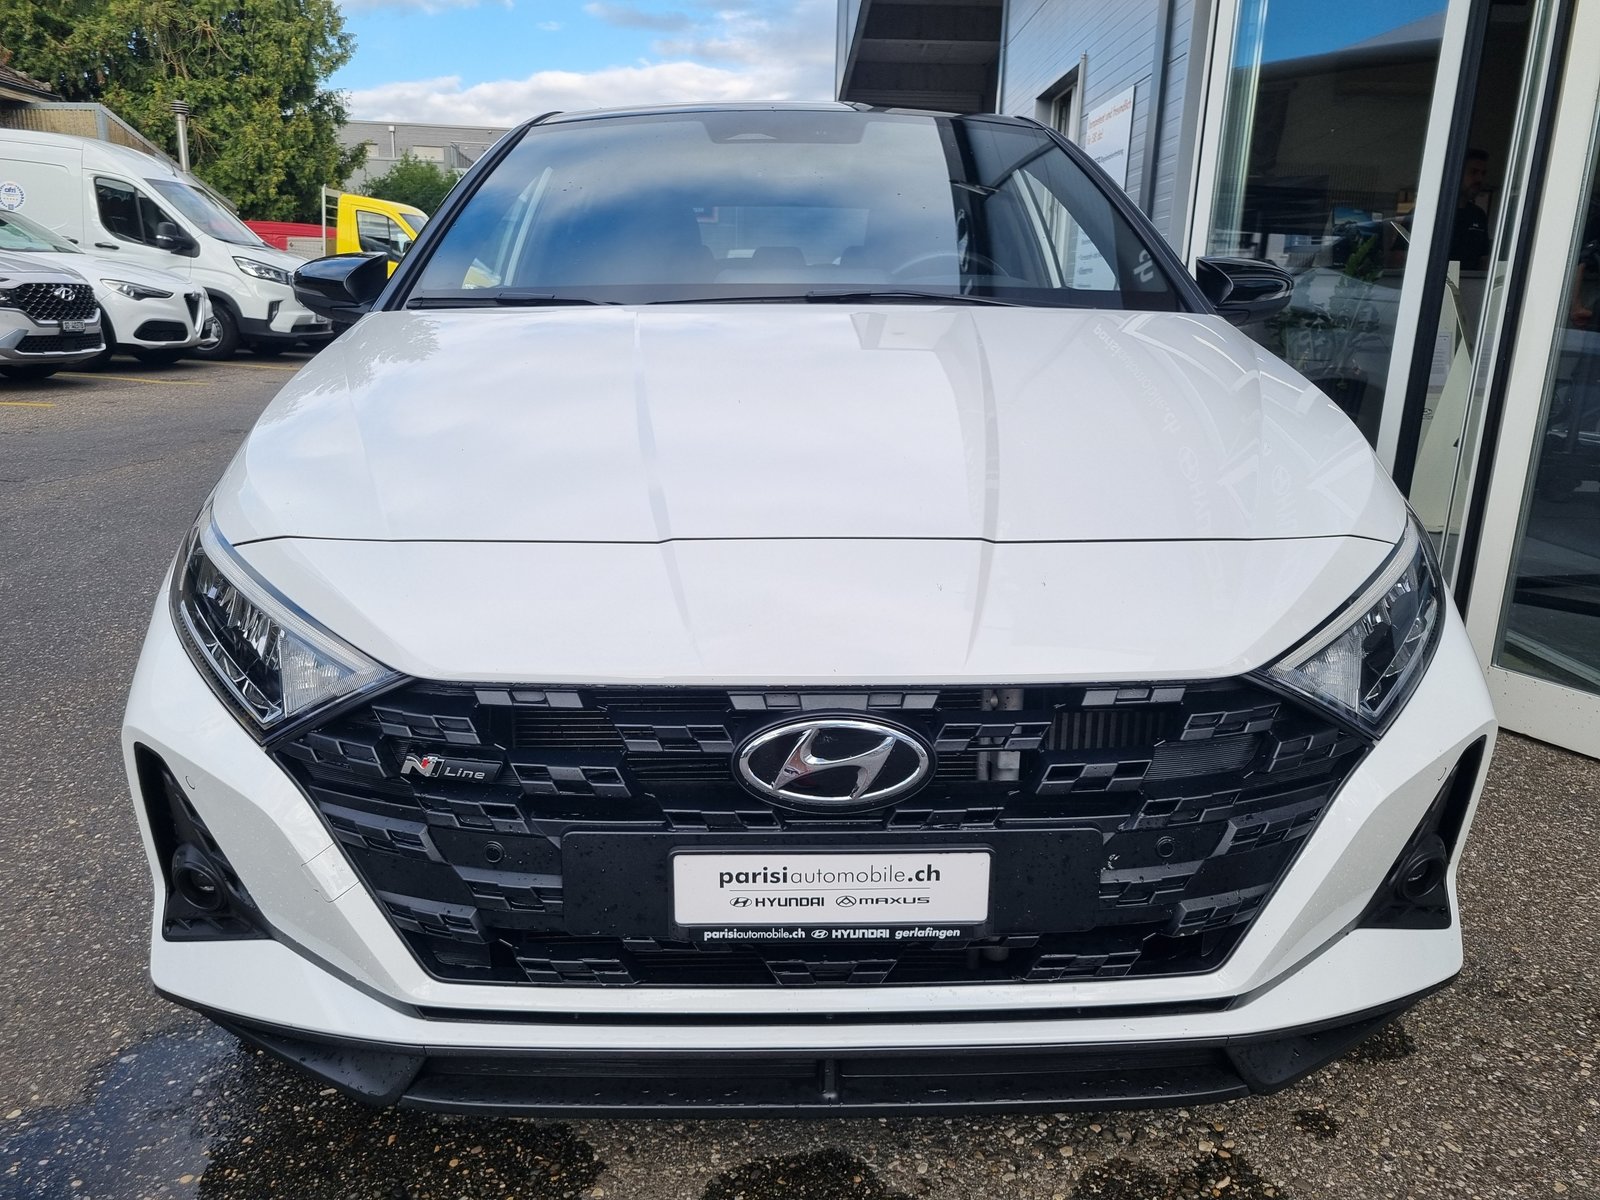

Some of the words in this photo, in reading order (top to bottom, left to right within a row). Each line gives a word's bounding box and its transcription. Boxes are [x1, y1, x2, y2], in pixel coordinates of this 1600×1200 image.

[444, 767, 485, 779] Line
[719, 864, 941, 888] parisiautomobile.ch
[755, 897, 824, 907] HYUNDAI
[859, 896, 930, 904] MAXUS
[704, 928, 805, 941] parisiautomobile.ch
[832, 929, 889, 938] HYUNDAI
[895, 927, 960, 939] gerlafingen
